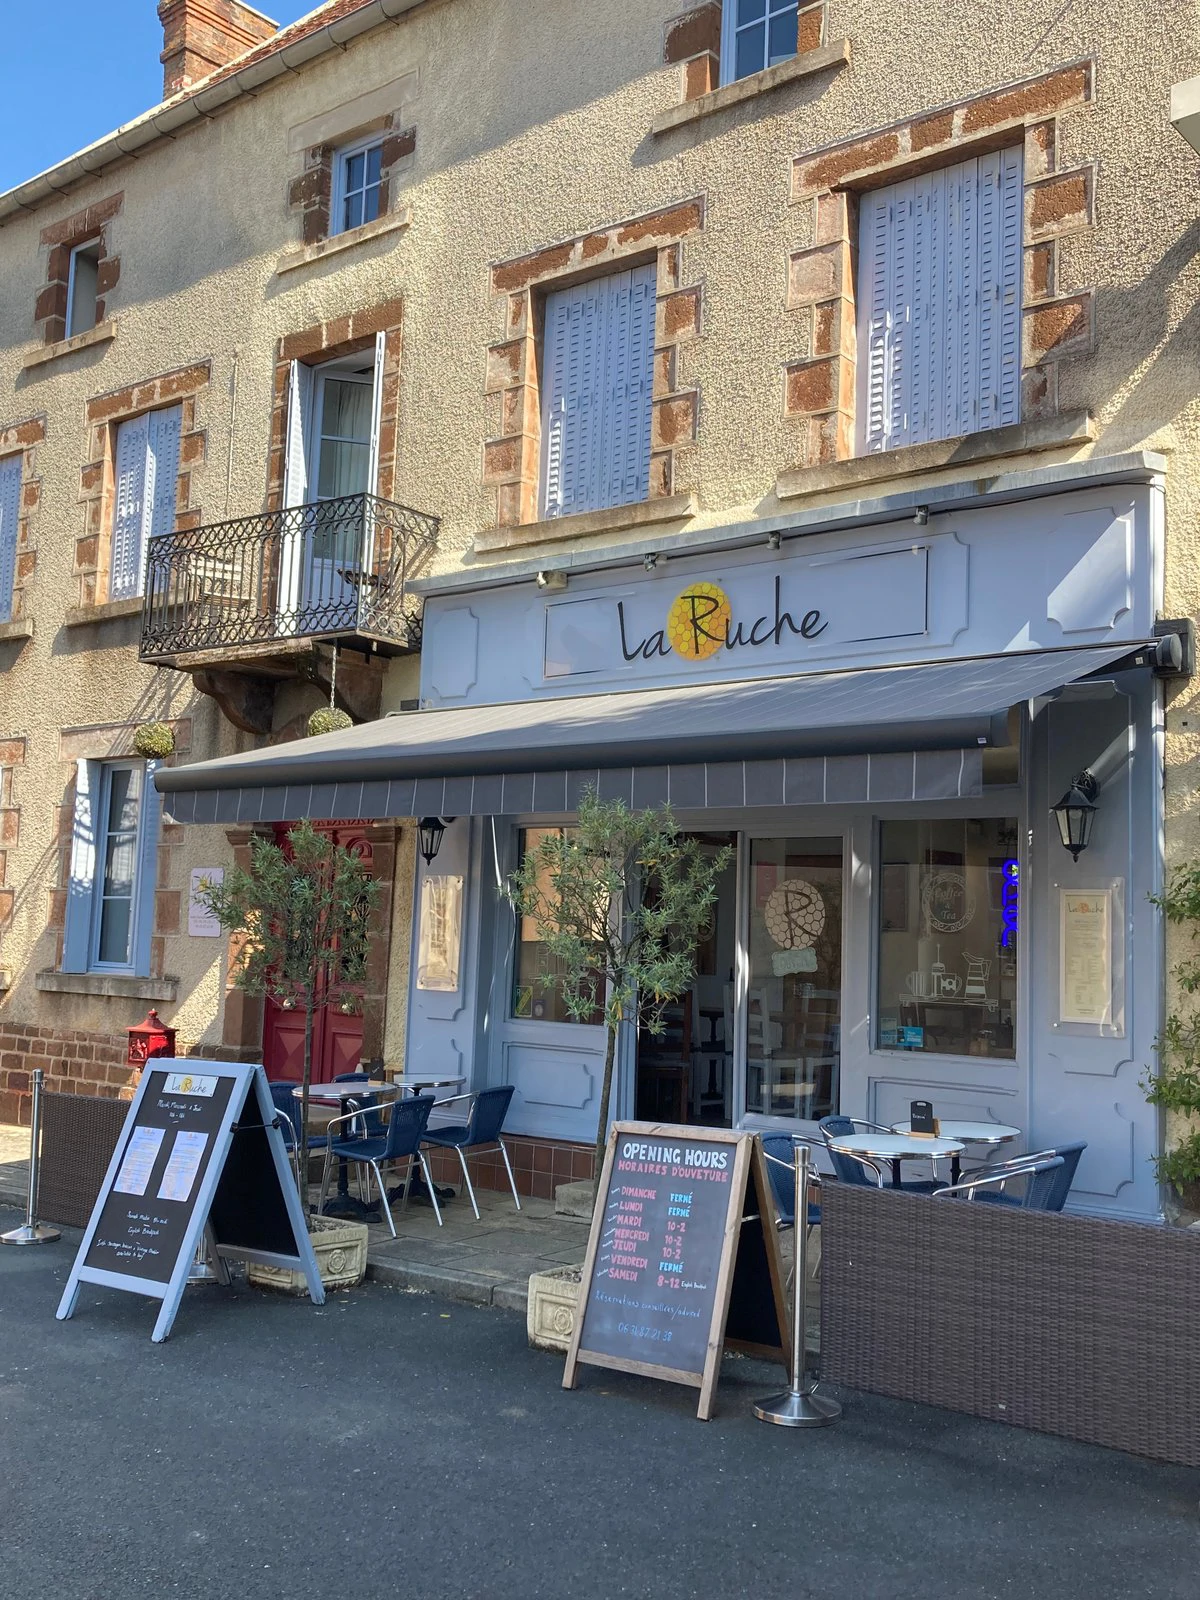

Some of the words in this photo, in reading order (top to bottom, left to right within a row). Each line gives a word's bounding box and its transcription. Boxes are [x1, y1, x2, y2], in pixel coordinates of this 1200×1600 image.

[617, 601, 672, 661] La
[680, 575, 829, 655] Ruche
[941, 910, 956, 920] Tea
[172, 1077, 181, 1091] La
[183, 1078, 206, 1093] Ruche
[623, 1143, 681, 1164] OPENING
[685, 1149, 728, 1169] HOURS
[618, 1160, 667, 1175] HORAIRES
[671, 1166, 729, 1182] D'OUVETURE
[621, 1186, 656, 1200] DIMANCHE
[670, 1191, 693, 1204] FERMÉ
[619, 1201, 643, 1212] LUNDI
[668, 1206, 691, 1217] FERMÉ
[616, 1215, 642, 1227] MARDI
[614, 1228, 649, 1241] MERCREDI
[612, 1239, 637, 1252] JEUDI
[611, 1254, 648, 1269] VENDREDI
[659, 1262, 685, 1273] FERMÉ
[608, 1267, 638, 1282] SAMEDI
